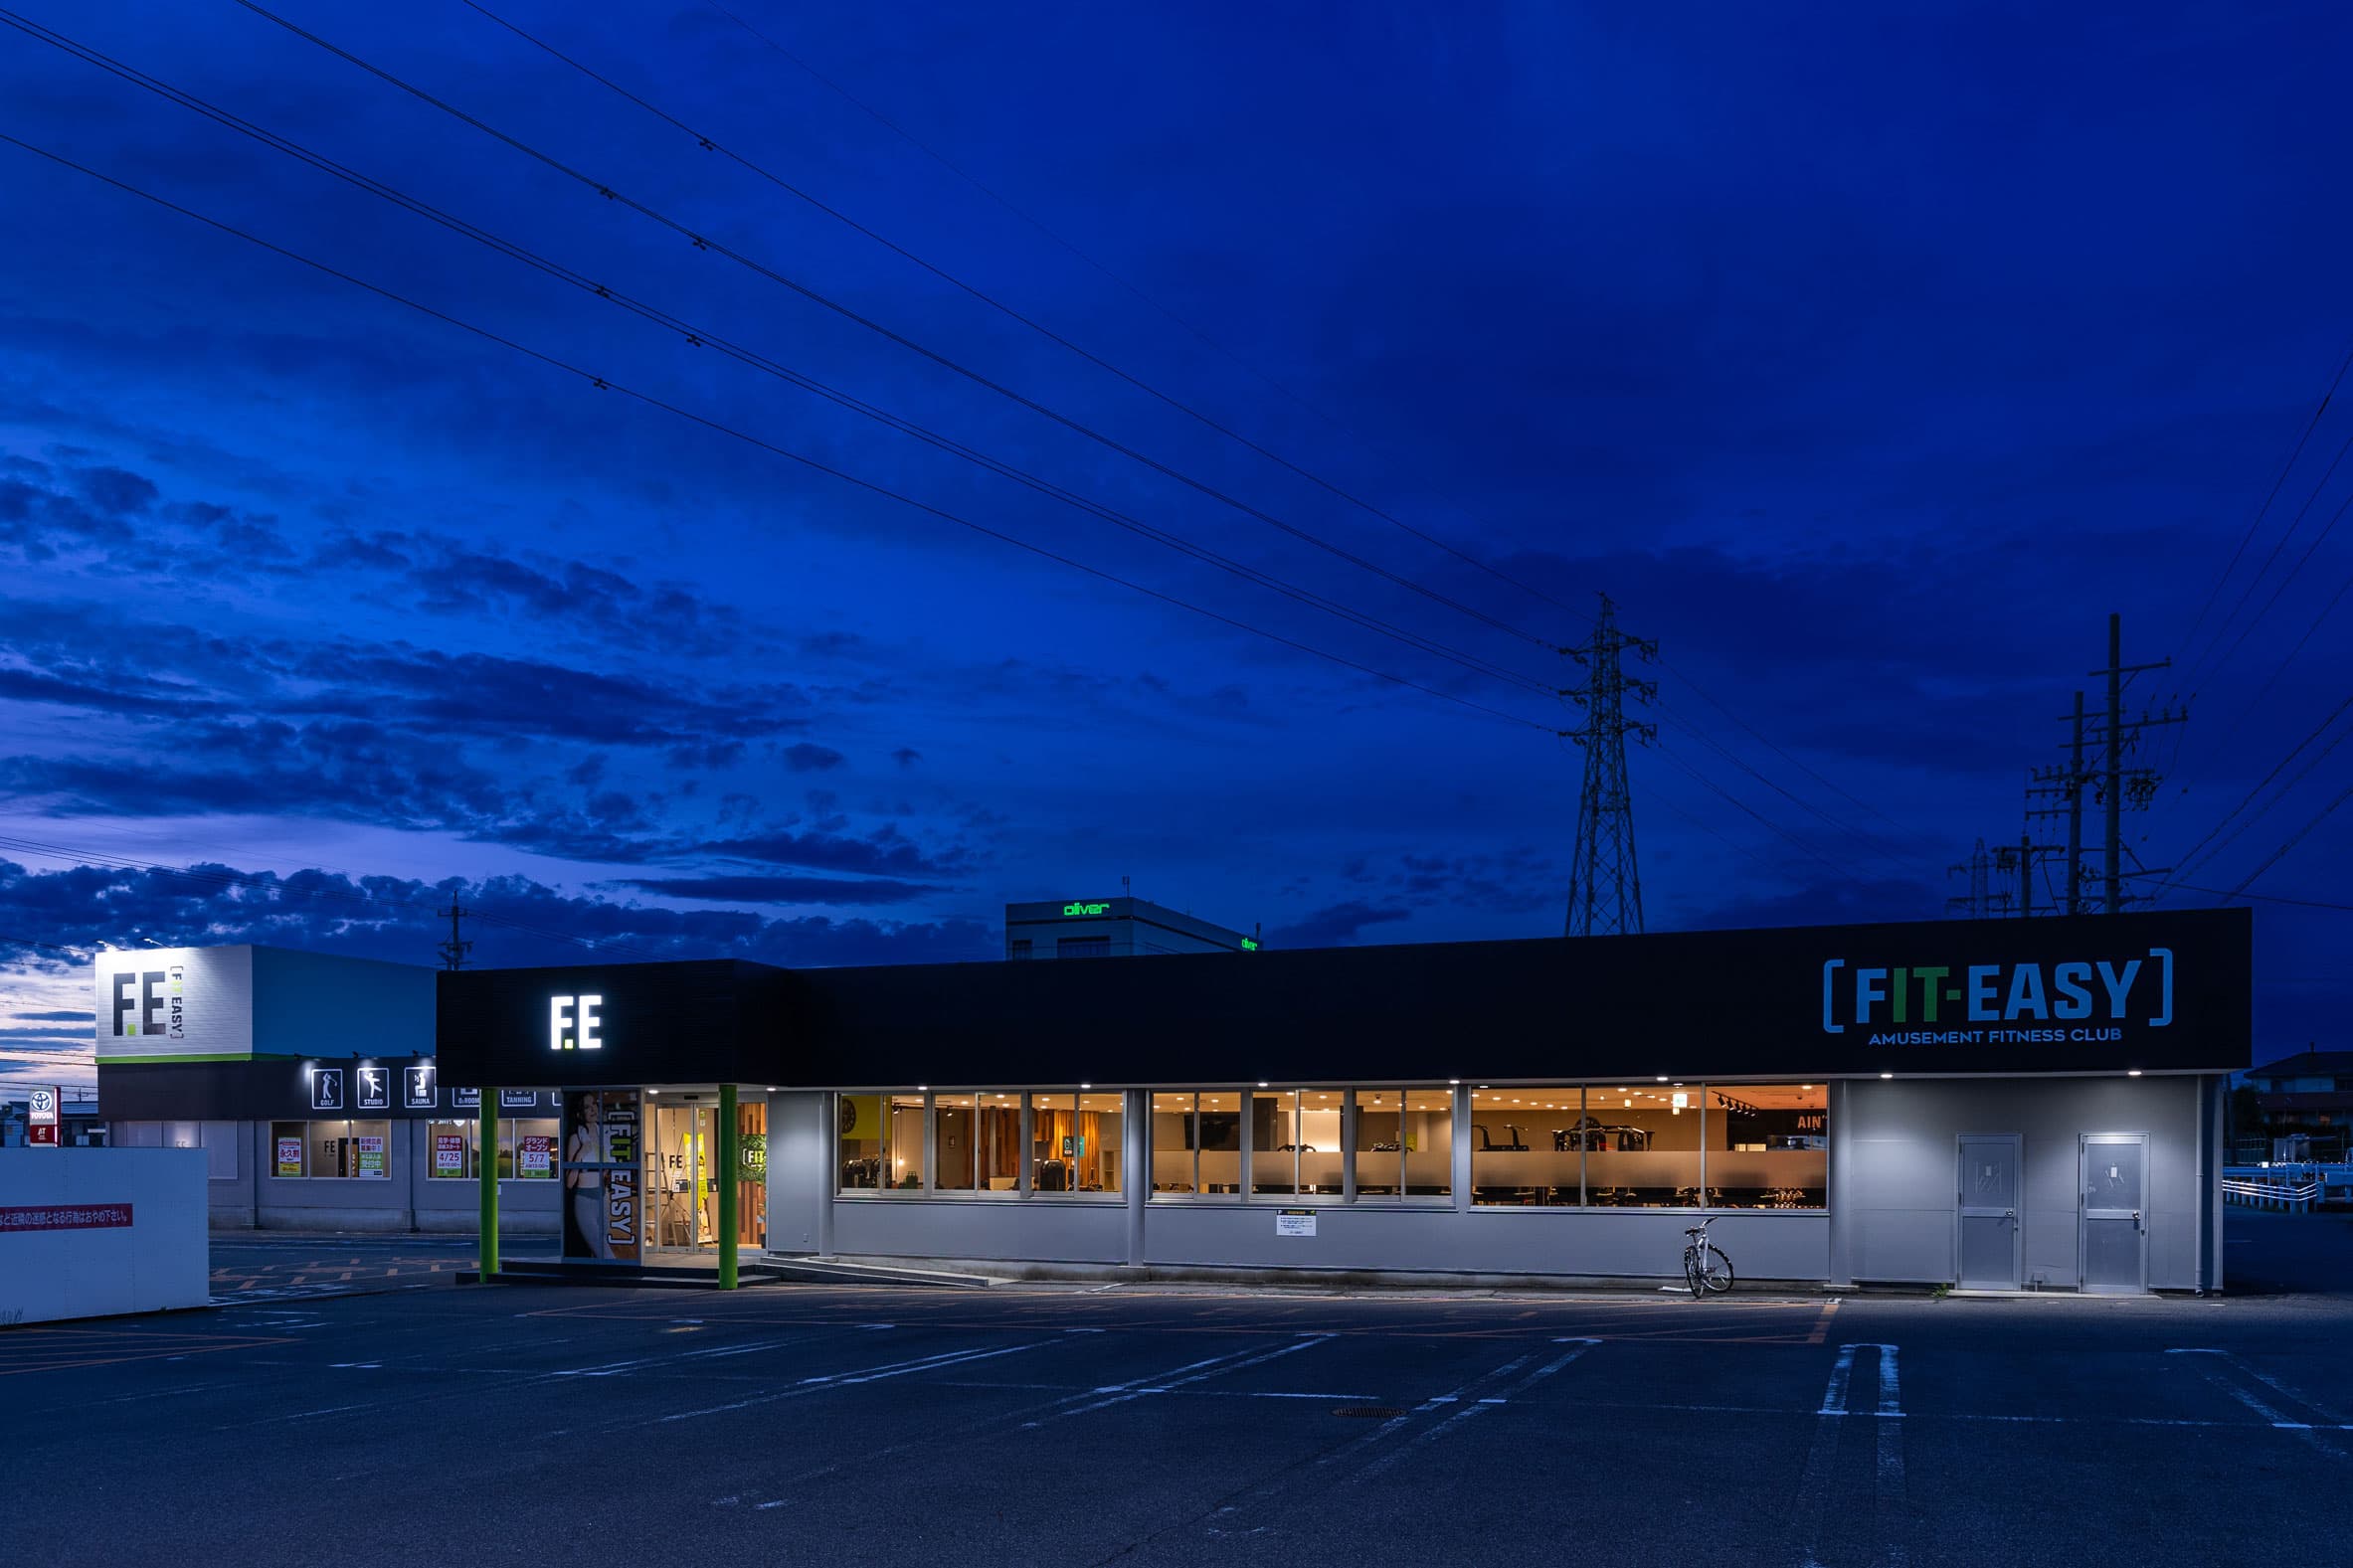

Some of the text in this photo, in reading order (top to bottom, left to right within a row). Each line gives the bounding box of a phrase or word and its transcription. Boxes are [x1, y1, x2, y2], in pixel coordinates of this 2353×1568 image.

[1869, 1027, 2122, 1046] AMUSEMENT FITNESS CLUB
[439, 1152, 459, 1162] 4/25
[529, 1153, 545, 1163] 5/7
